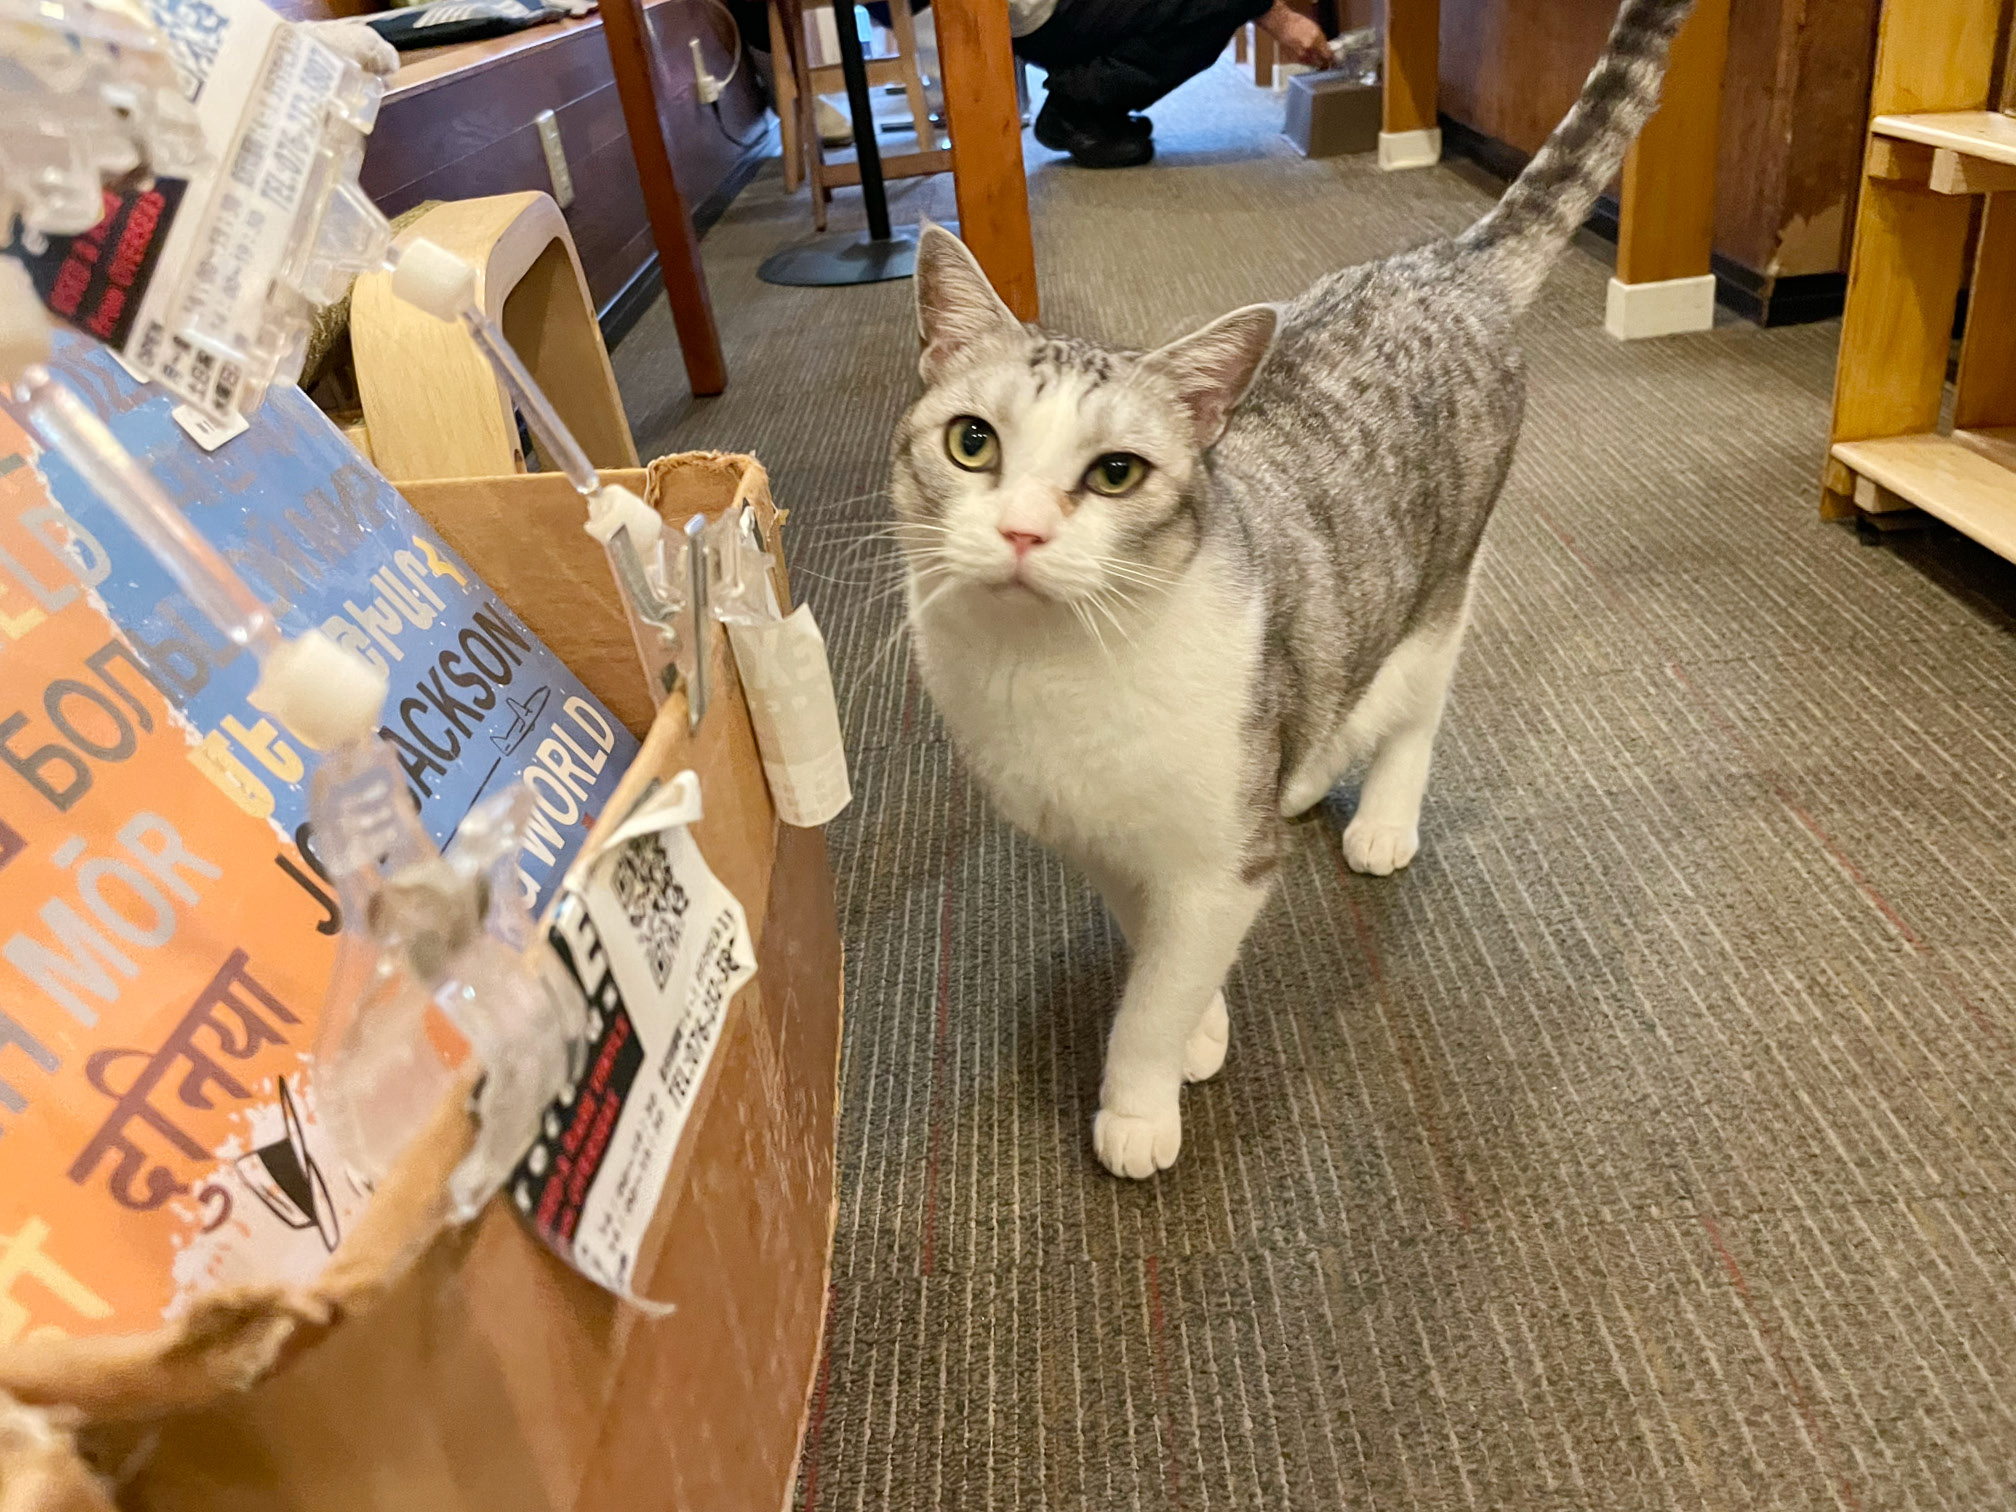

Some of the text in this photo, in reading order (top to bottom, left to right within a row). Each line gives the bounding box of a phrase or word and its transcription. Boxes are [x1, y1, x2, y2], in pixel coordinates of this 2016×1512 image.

[187, 695, 322, 819] ՄԵ
[378, 601, 532, 815] ACKSON
[521, 694, 616, 868] WORLD
